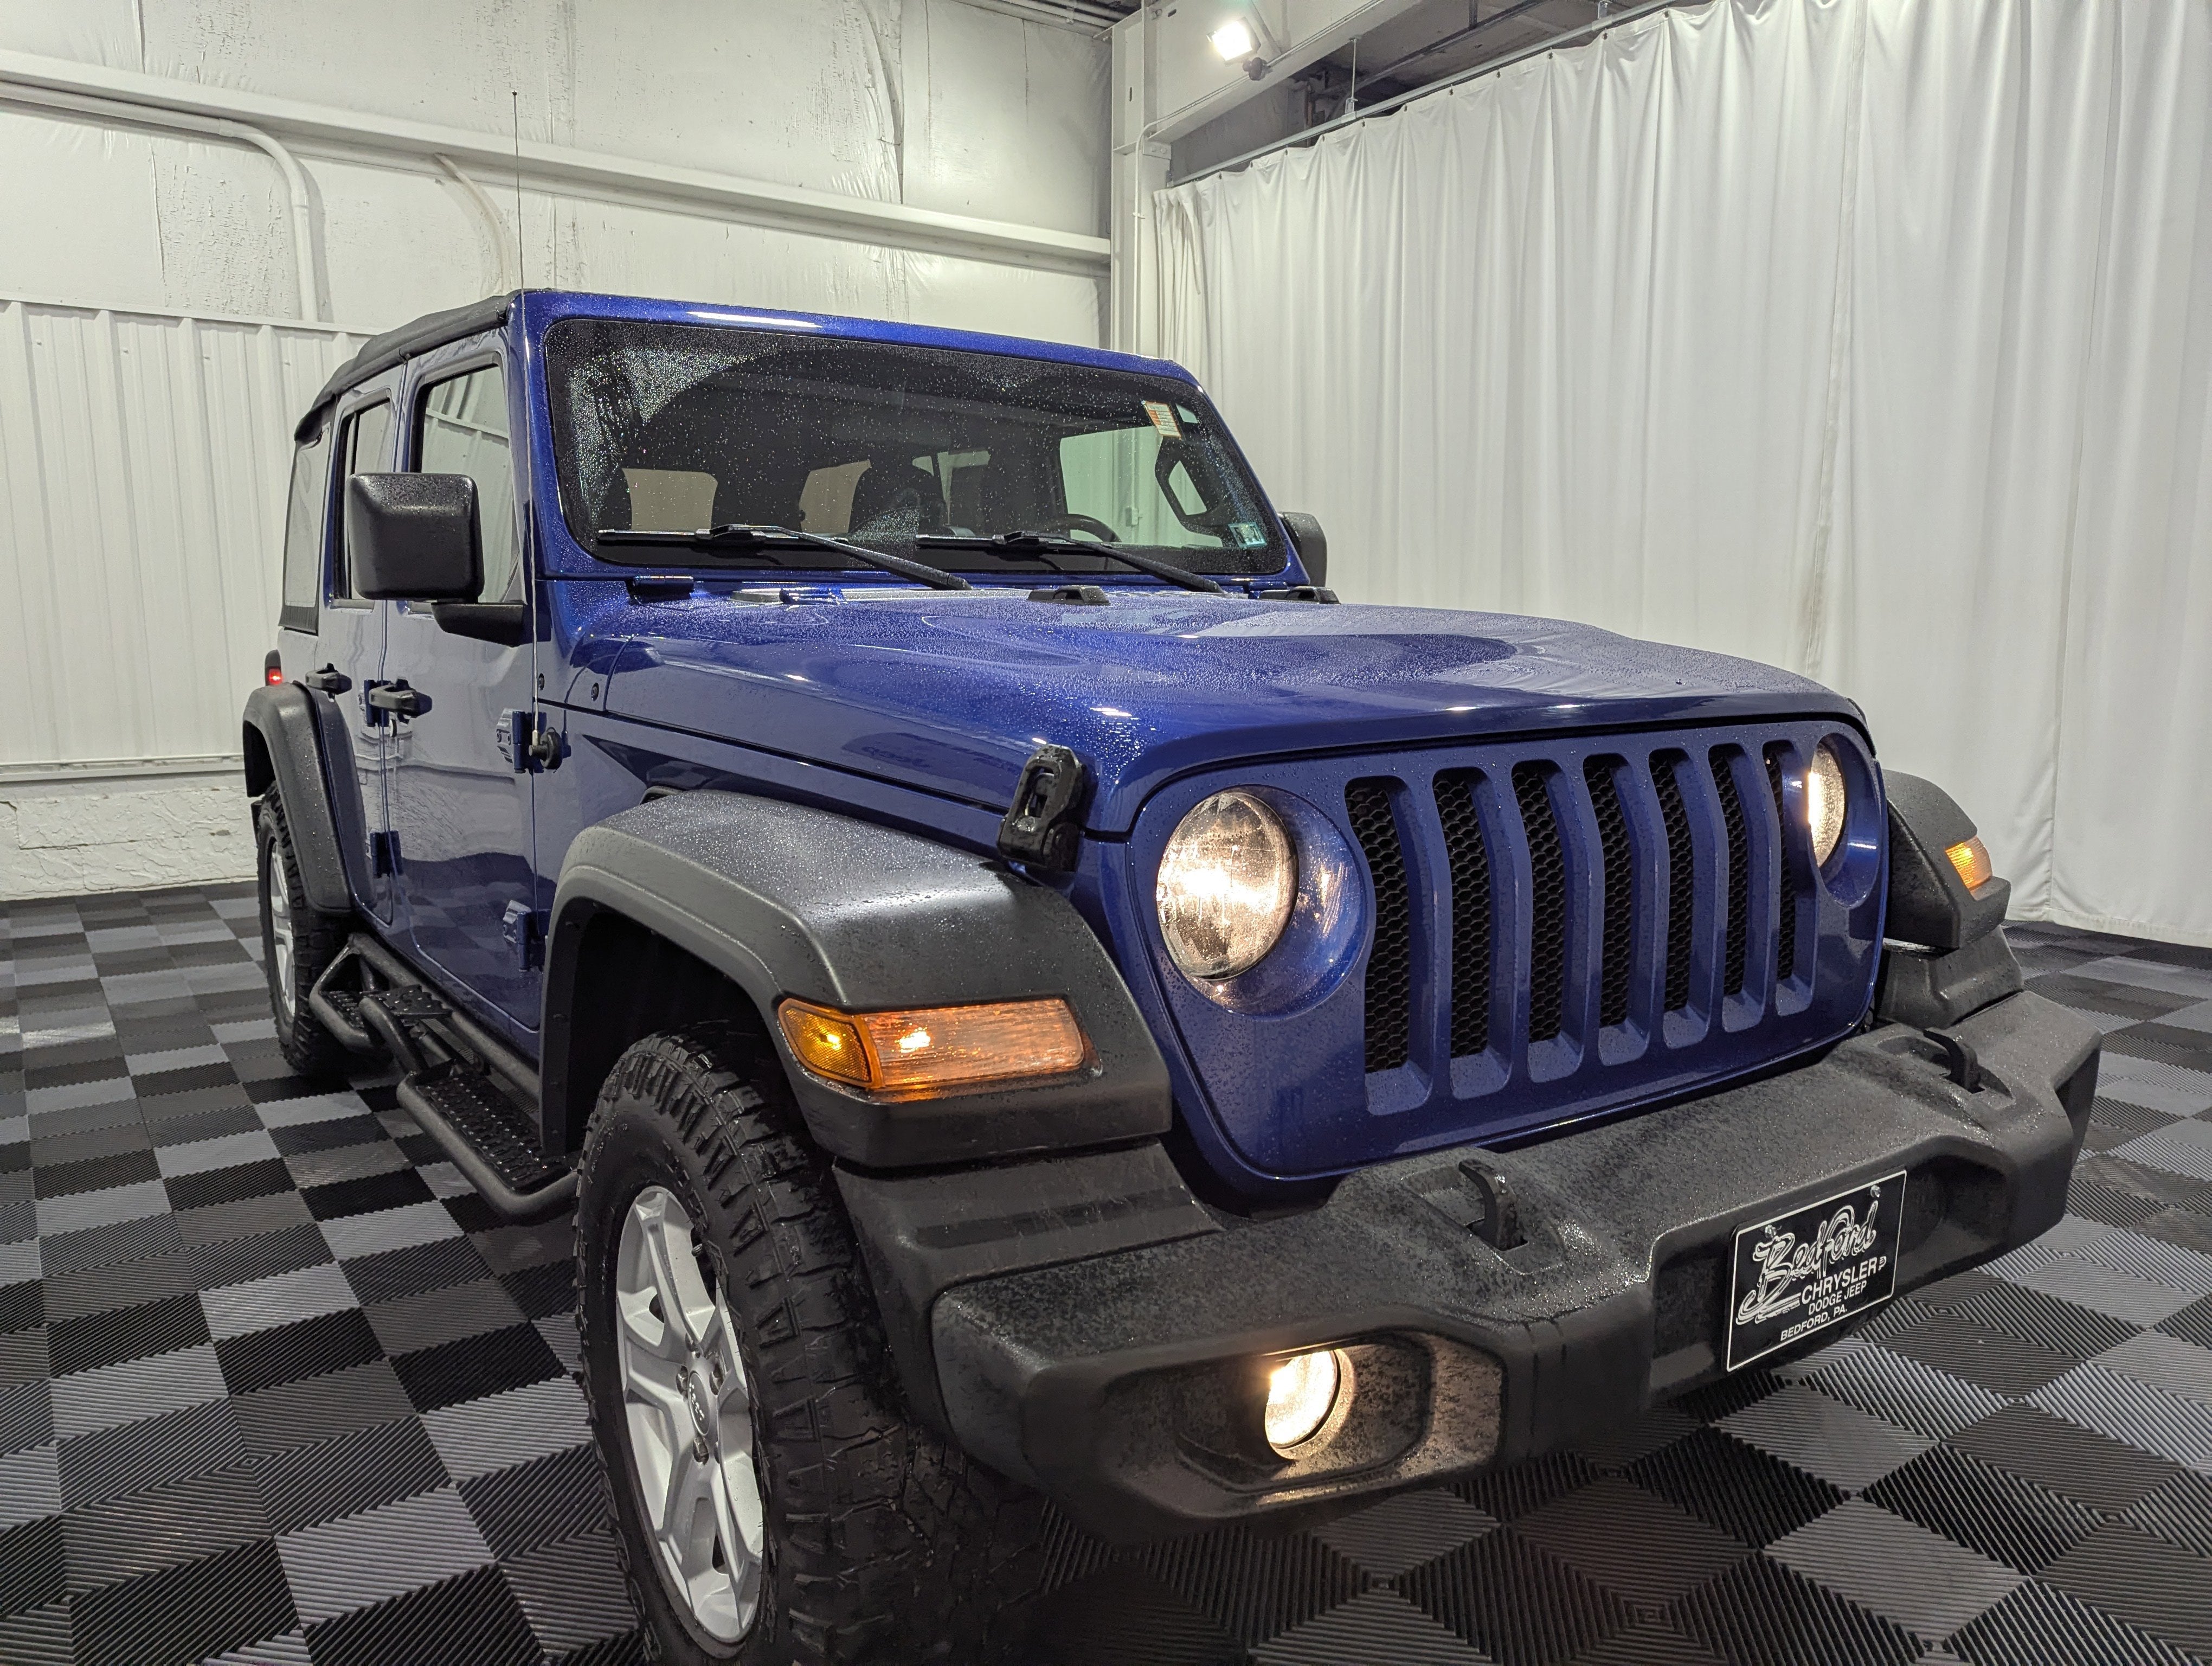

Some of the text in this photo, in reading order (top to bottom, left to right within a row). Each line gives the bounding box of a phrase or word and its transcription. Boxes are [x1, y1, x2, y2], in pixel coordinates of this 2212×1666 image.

[1736, 1200, 1879, 1325] Bedford
[1802, 1257, 1877, 1304] CHRYSLER
[1809, 1280, 1867, 1315] DODGE JEEP
[1780, 1304, 1847, 1341] BEDFORD, PA.
